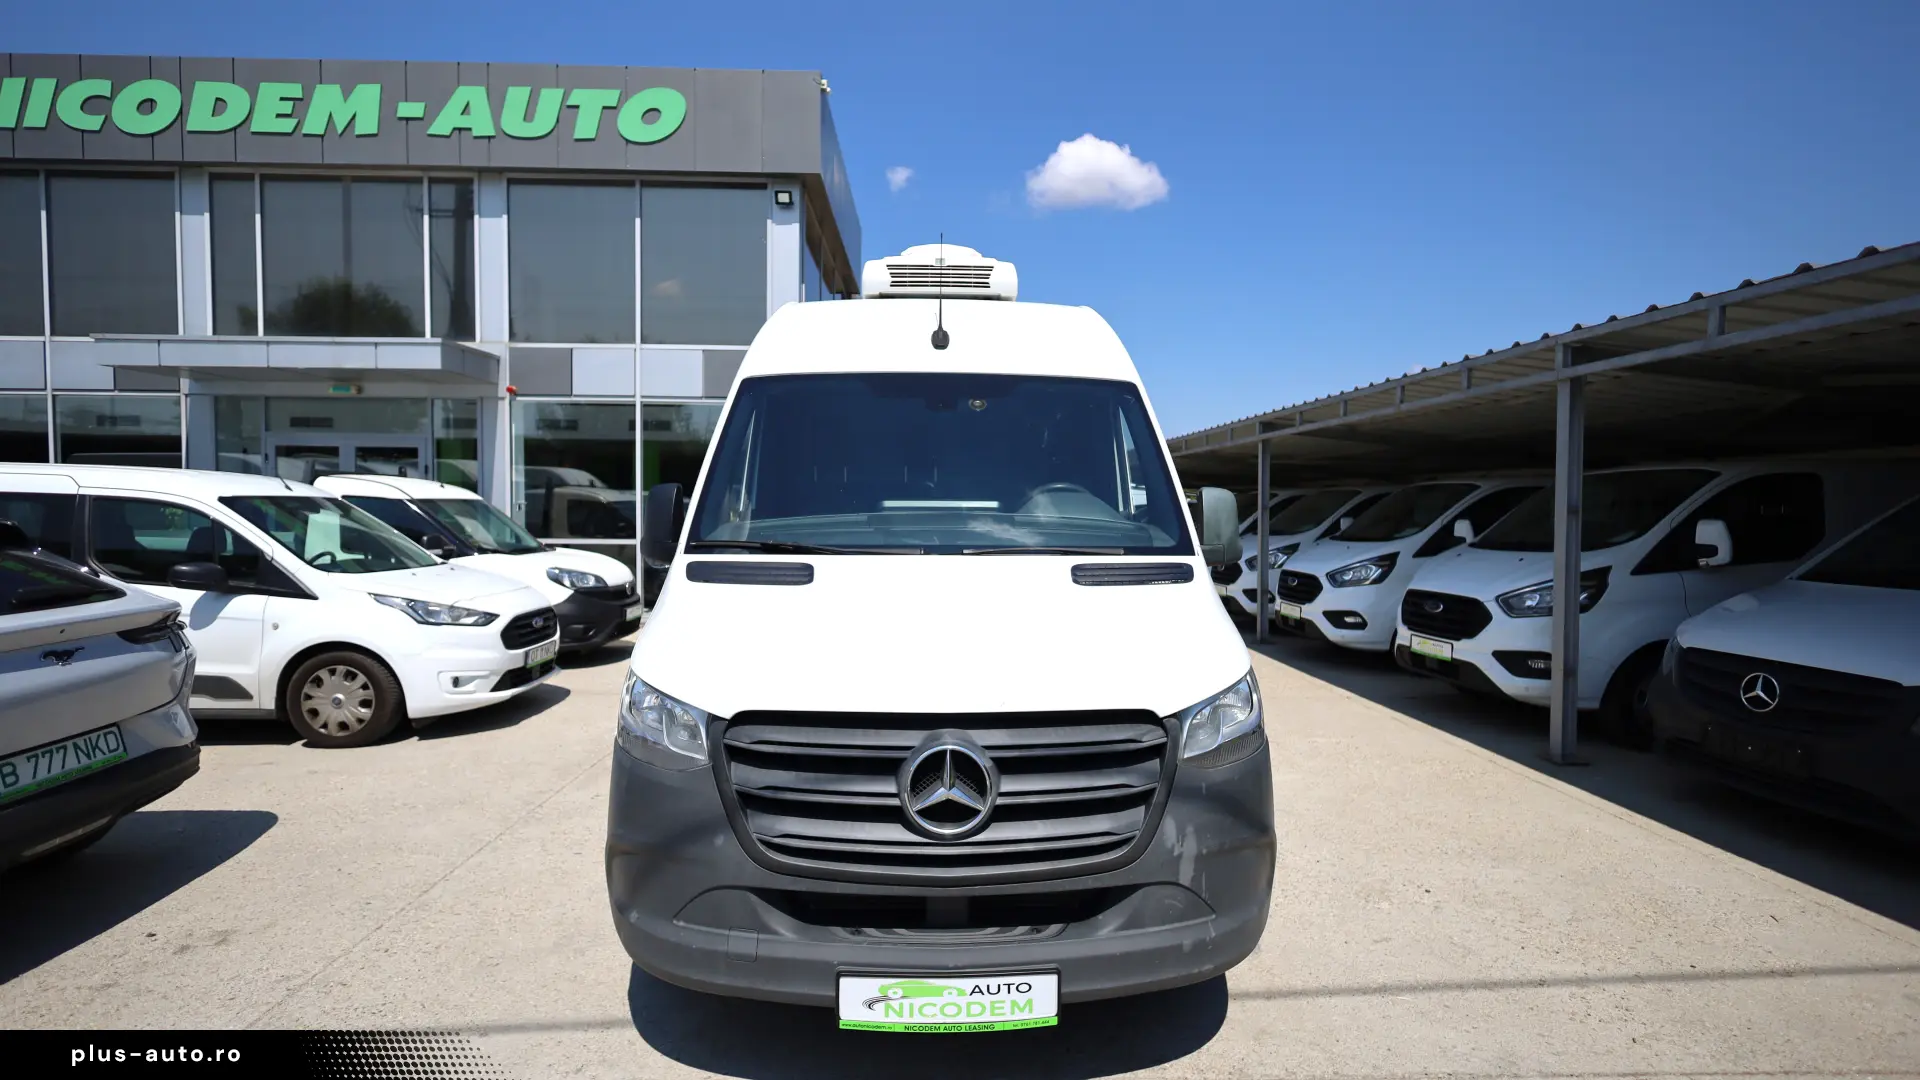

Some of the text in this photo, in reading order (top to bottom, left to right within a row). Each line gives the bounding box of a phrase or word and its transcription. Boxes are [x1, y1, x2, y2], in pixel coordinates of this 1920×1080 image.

[0, 760, 19, 789] B
[26, 744, 68, 780] 777
[72, 729, 121, 765] NKD
[969, 982, 1032, 996] AUTO
[884, 998, 1034, 1019] NICODEM
[964, 1023, 996, 1032] LEASING
